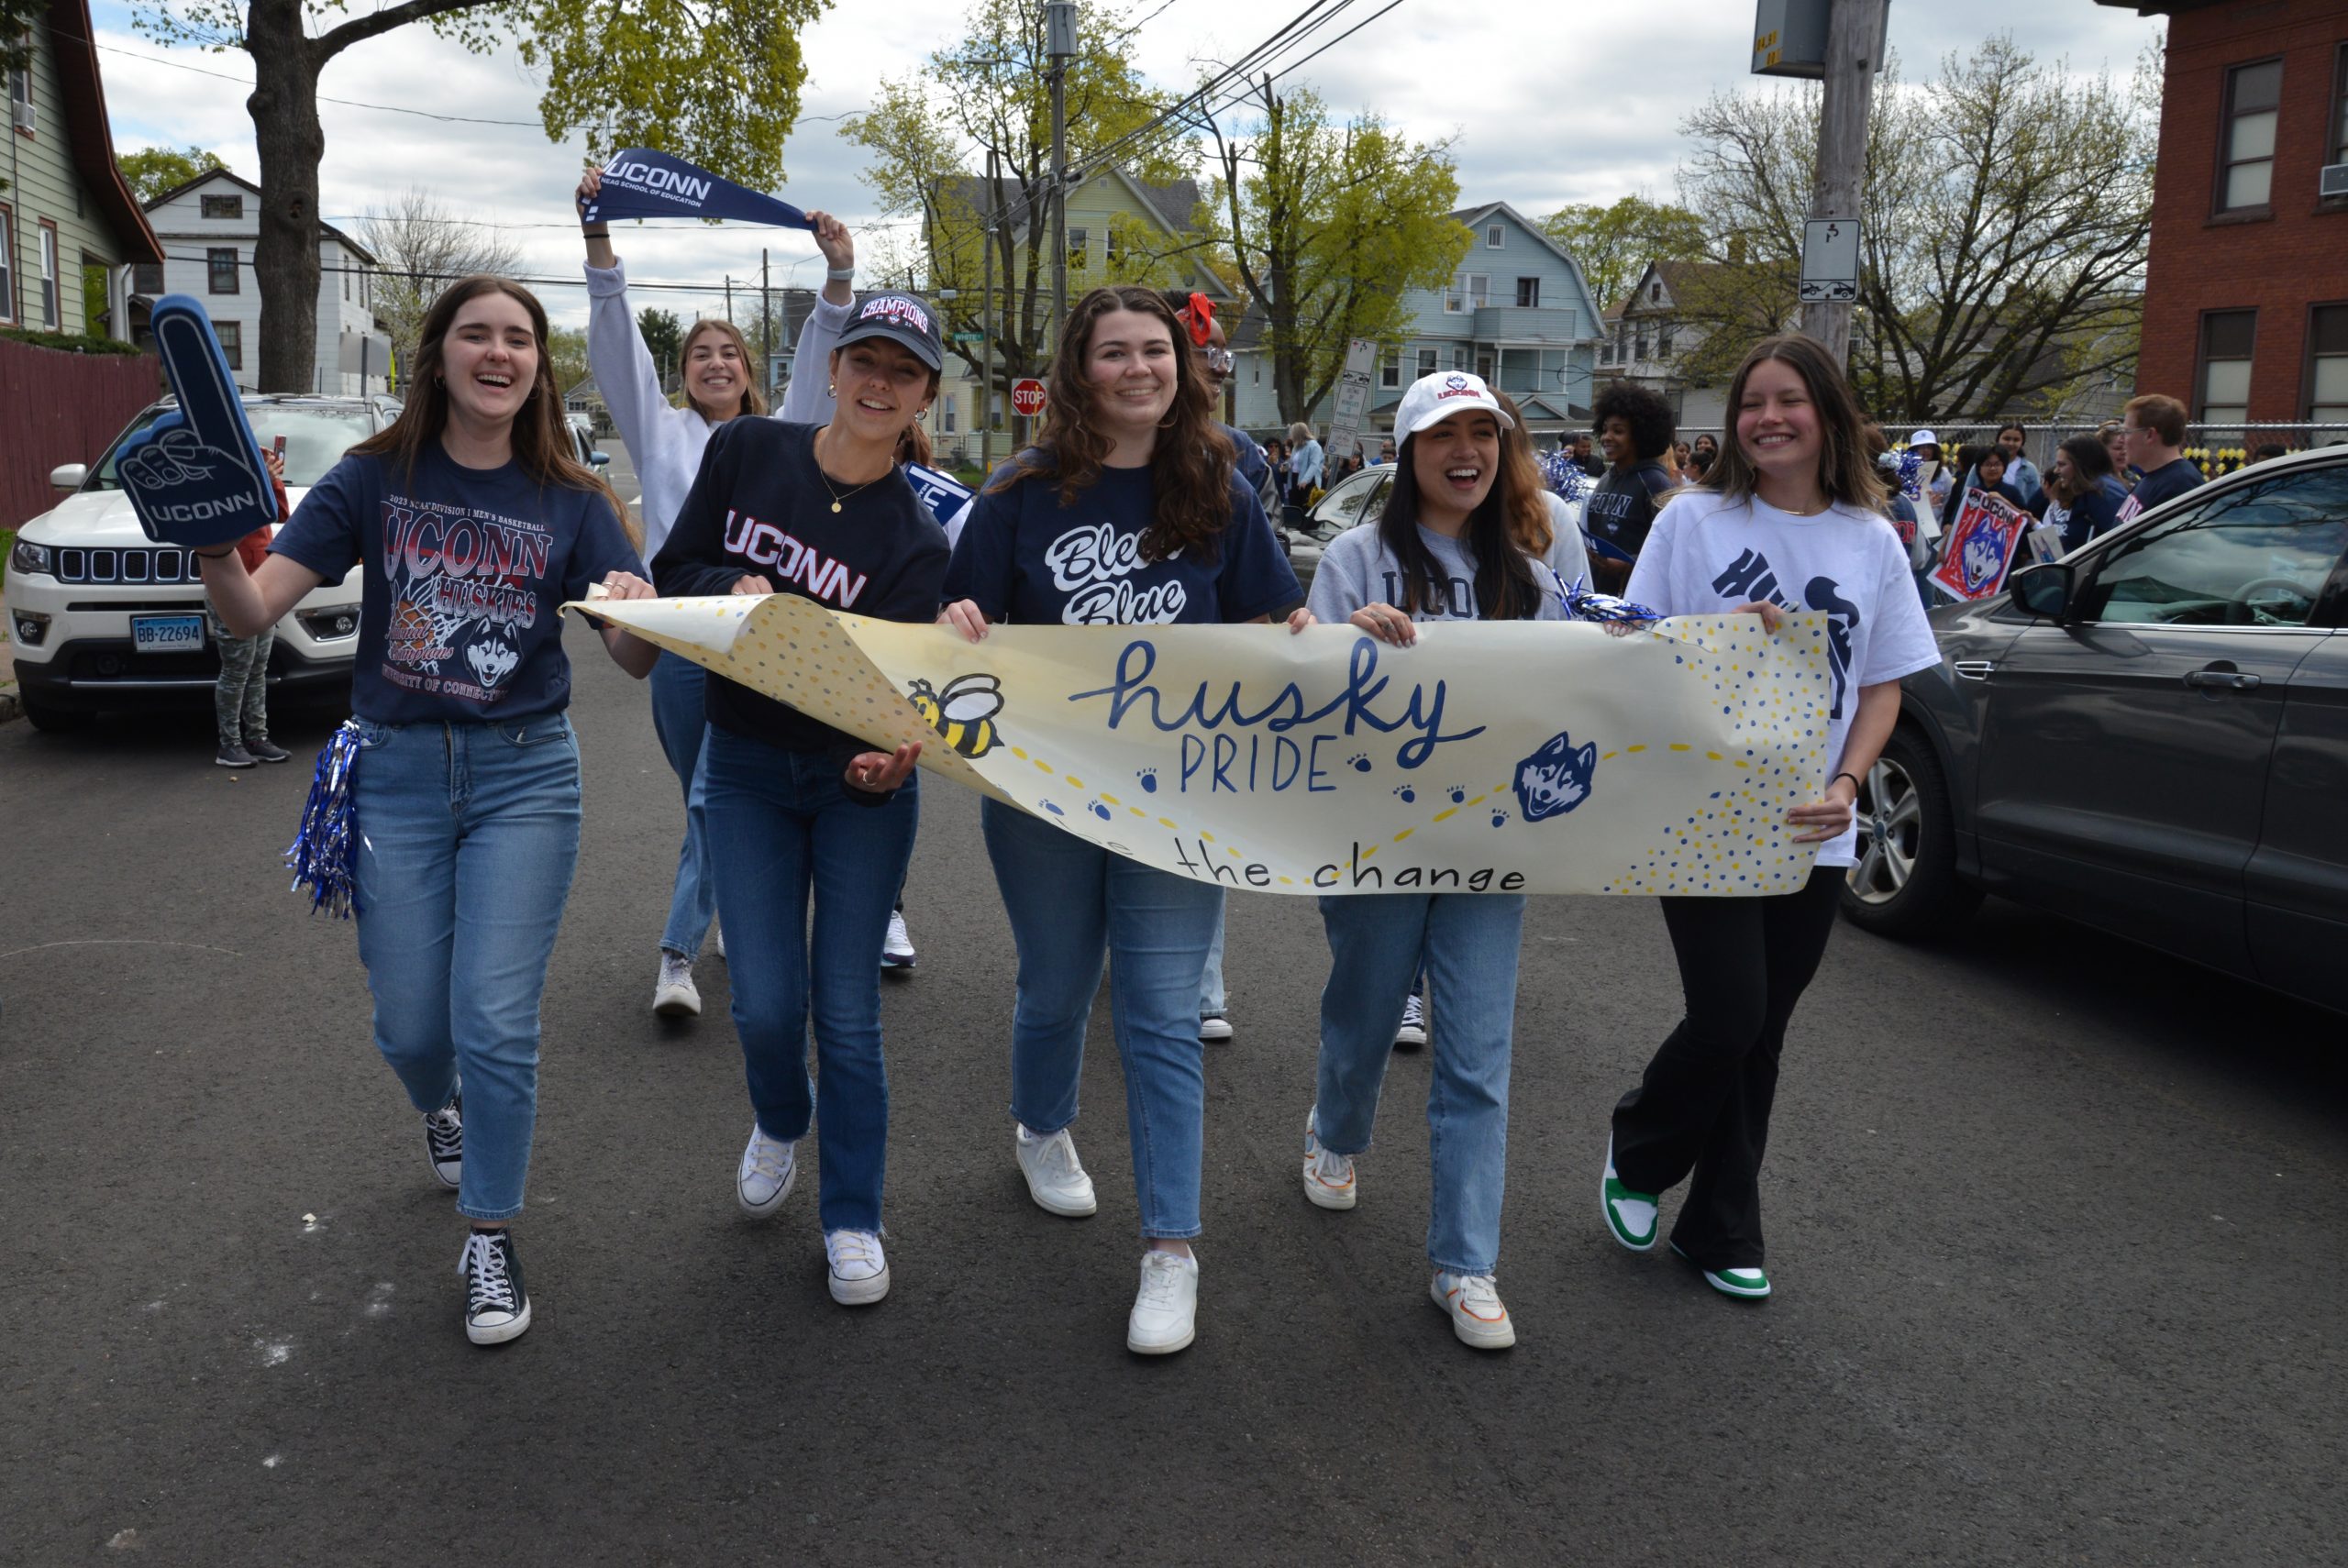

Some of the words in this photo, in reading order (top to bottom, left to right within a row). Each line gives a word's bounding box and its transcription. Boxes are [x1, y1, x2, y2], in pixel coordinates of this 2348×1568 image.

[600, 177, 620, 186] NEAG
[620, 181, 648, 193] SCHOOL
[660, 192, 702, 208] EDUCATION
[605, 161, 712, 201] UCONN
[860, 298, 928, 334] CHAMPIONS
[1014, 390, 1045, 404] STOP
[1437, 390, 1481, 400] UCONN
[150, 491, 255, 522] UCONN
[390, 494, 408, 505] 2023
[431, 502, 465, 516] DIVISION
[472, 509, 496, 521] MEN'S
[498, 515, 546, 532] BASKETBALL
[380, 501, 554, 582] UCONN
[724, 509, 867, 609] UCONN
[435, 575, 537, 630] HUSKIES
[1062, 580, 1187, 625] Blue
[425, 678, 441, 692] OF
[1068, 637, 1487, 770] husky
[1180, 733, 1338, 793] PRIDE
[1174, 836, 1272, 887] the
[1313, 841, 1526, 892] change
